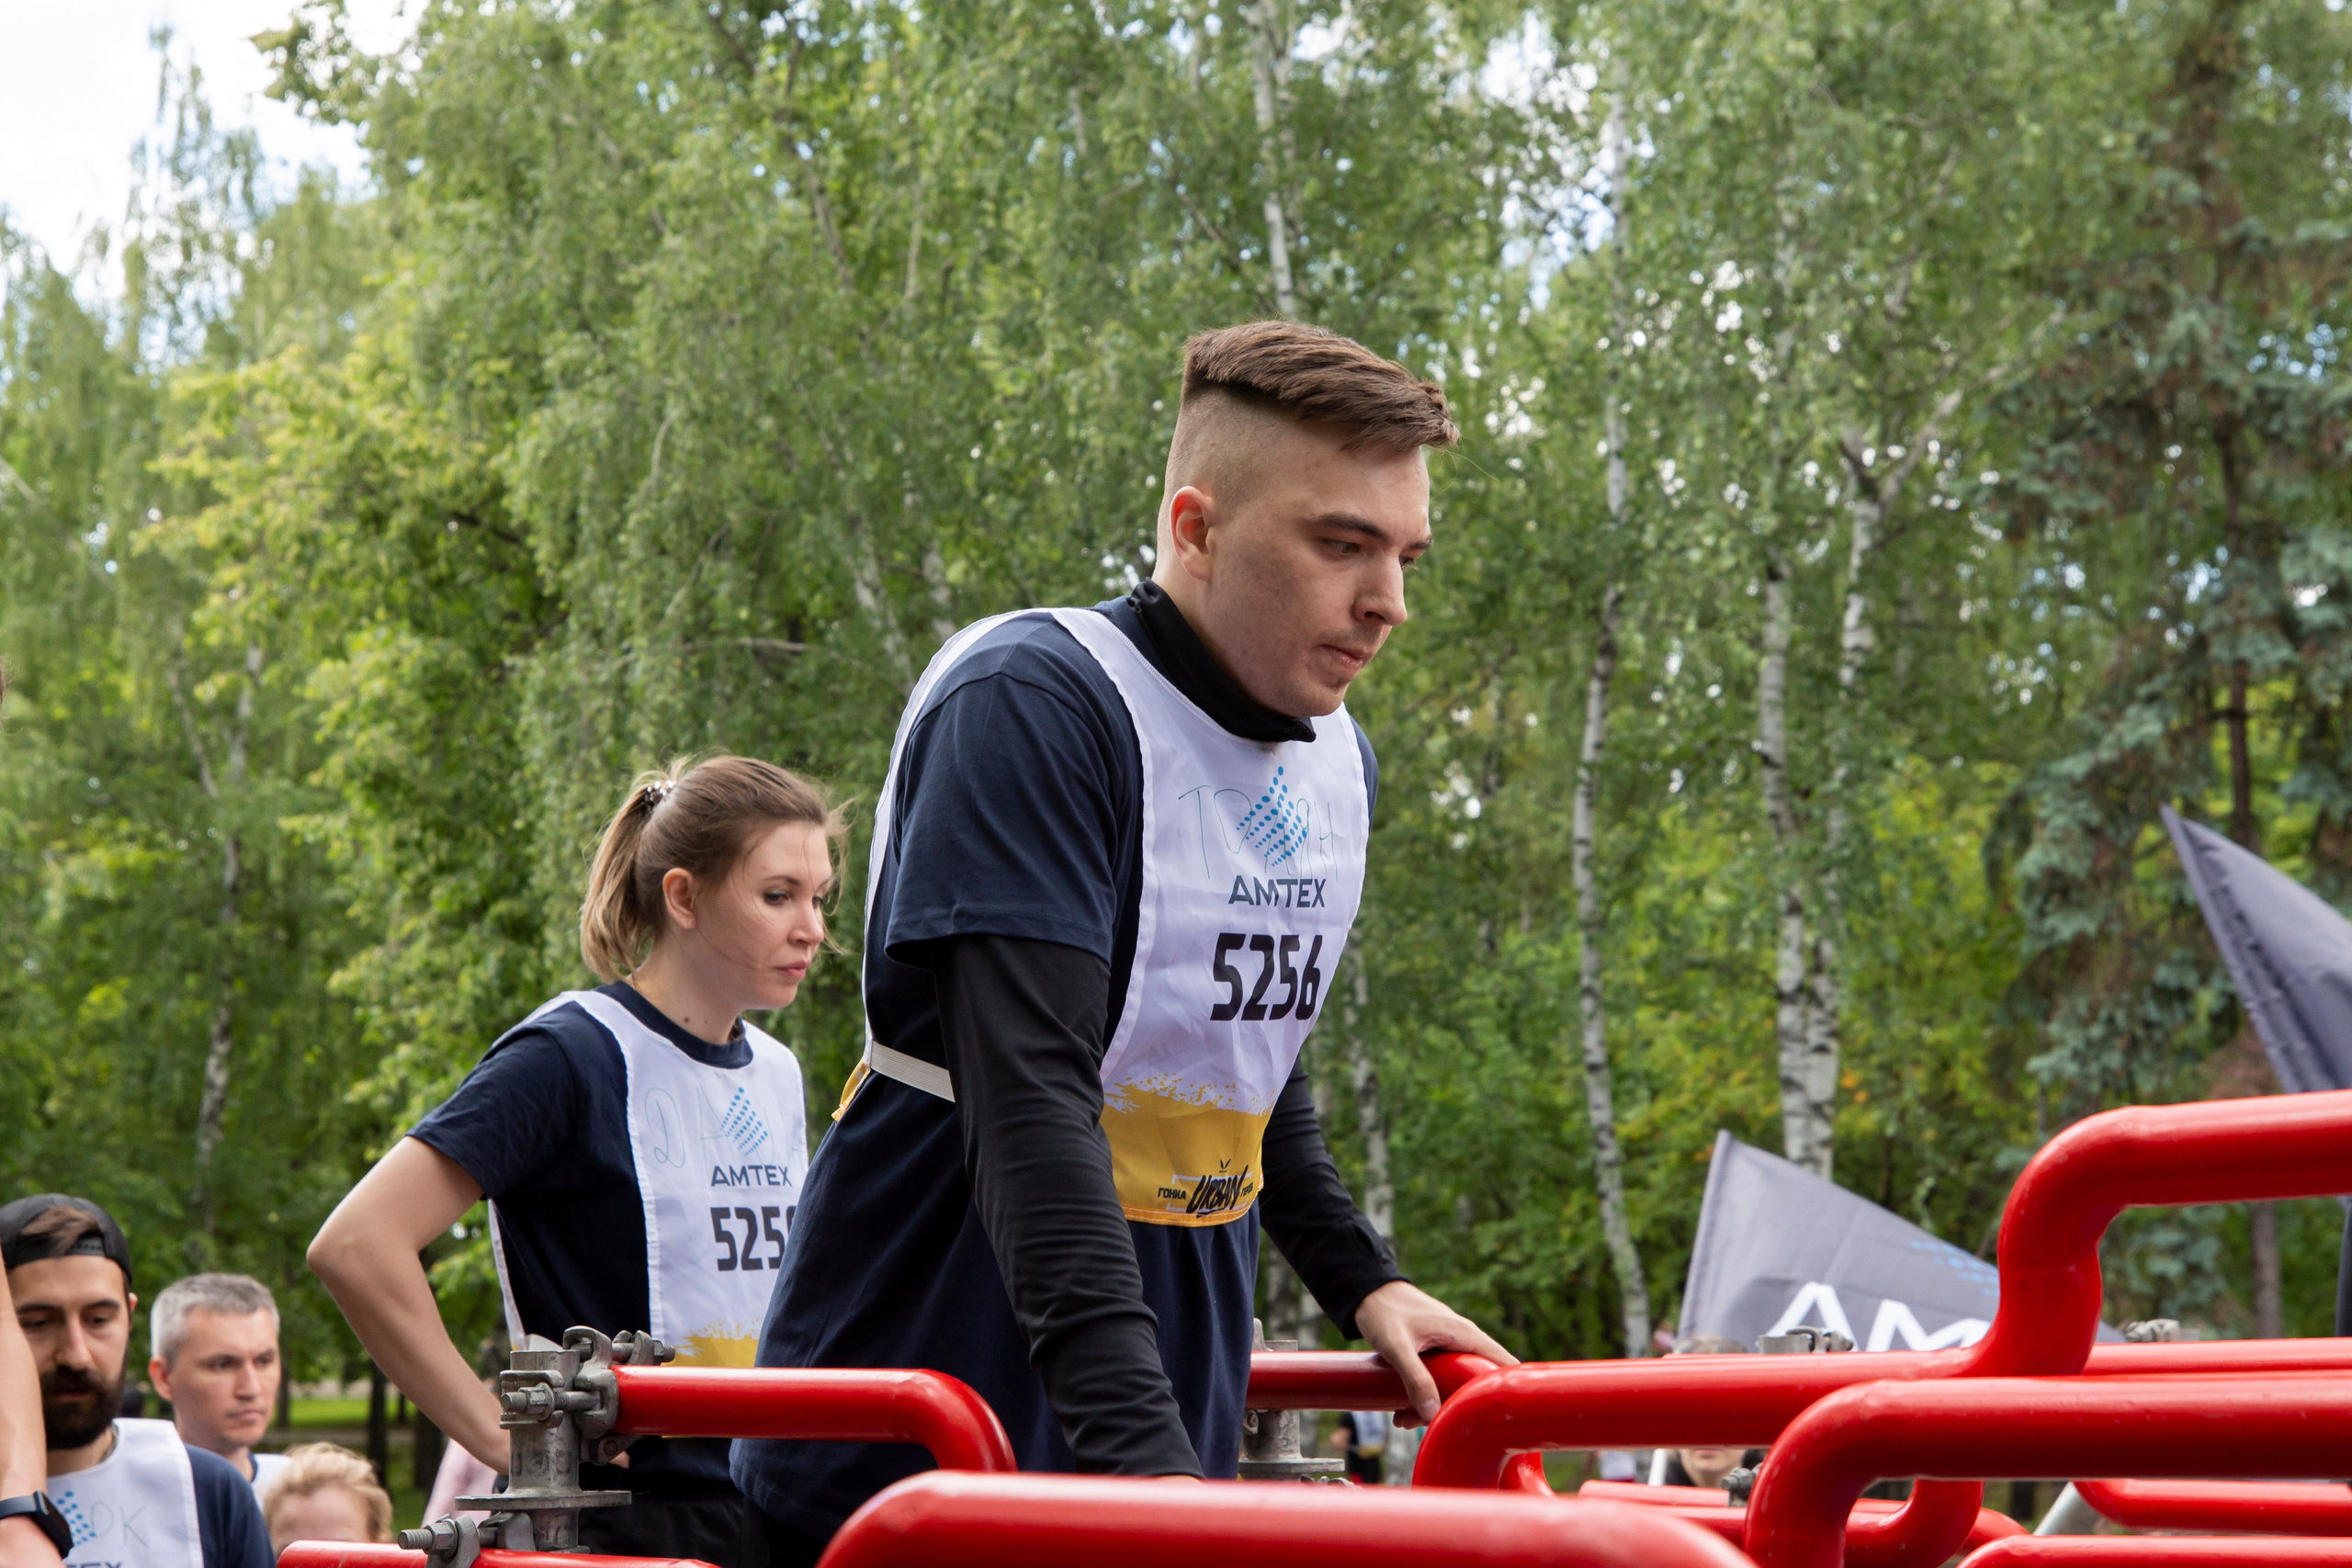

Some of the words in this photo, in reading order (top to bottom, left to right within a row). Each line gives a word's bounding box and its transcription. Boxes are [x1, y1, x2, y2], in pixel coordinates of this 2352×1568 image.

[1227, 874, 1326, 908] AMTEX
[1210, 932, 1323, 1021] 5256
[710, 1164, 793, 1187] AMTEX
[1158, 1187, 1186, 1200] ГОНКА
[1186, 1165, 1249, 1218] URBAN
